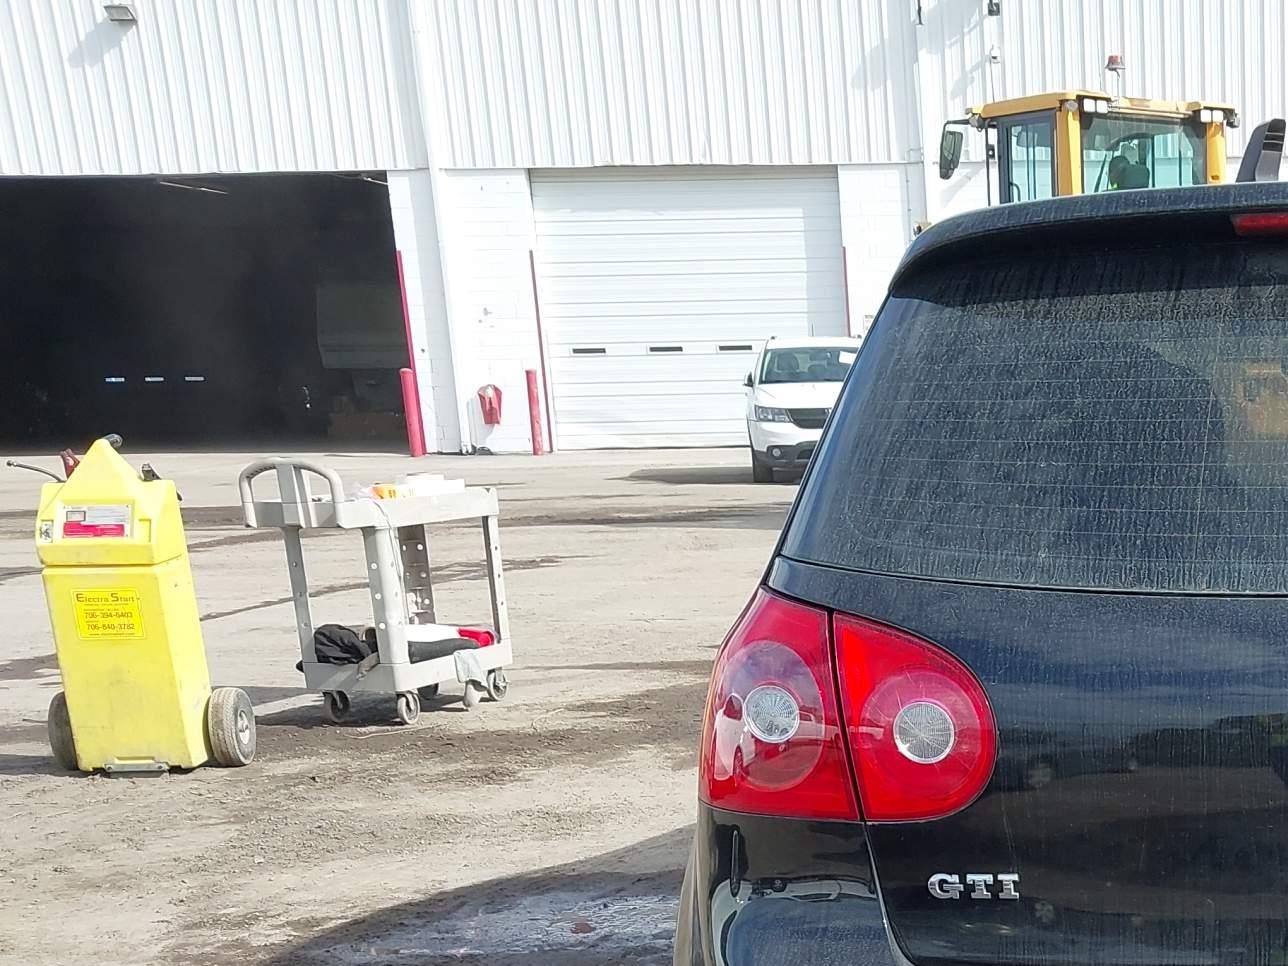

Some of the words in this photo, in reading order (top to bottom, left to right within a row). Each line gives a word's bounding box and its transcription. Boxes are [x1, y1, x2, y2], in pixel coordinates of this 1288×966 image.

[75, 592, 110, 603] Electra
[110, 592, 135, 603] Start
[927, 872, 1021, 900] GTI
